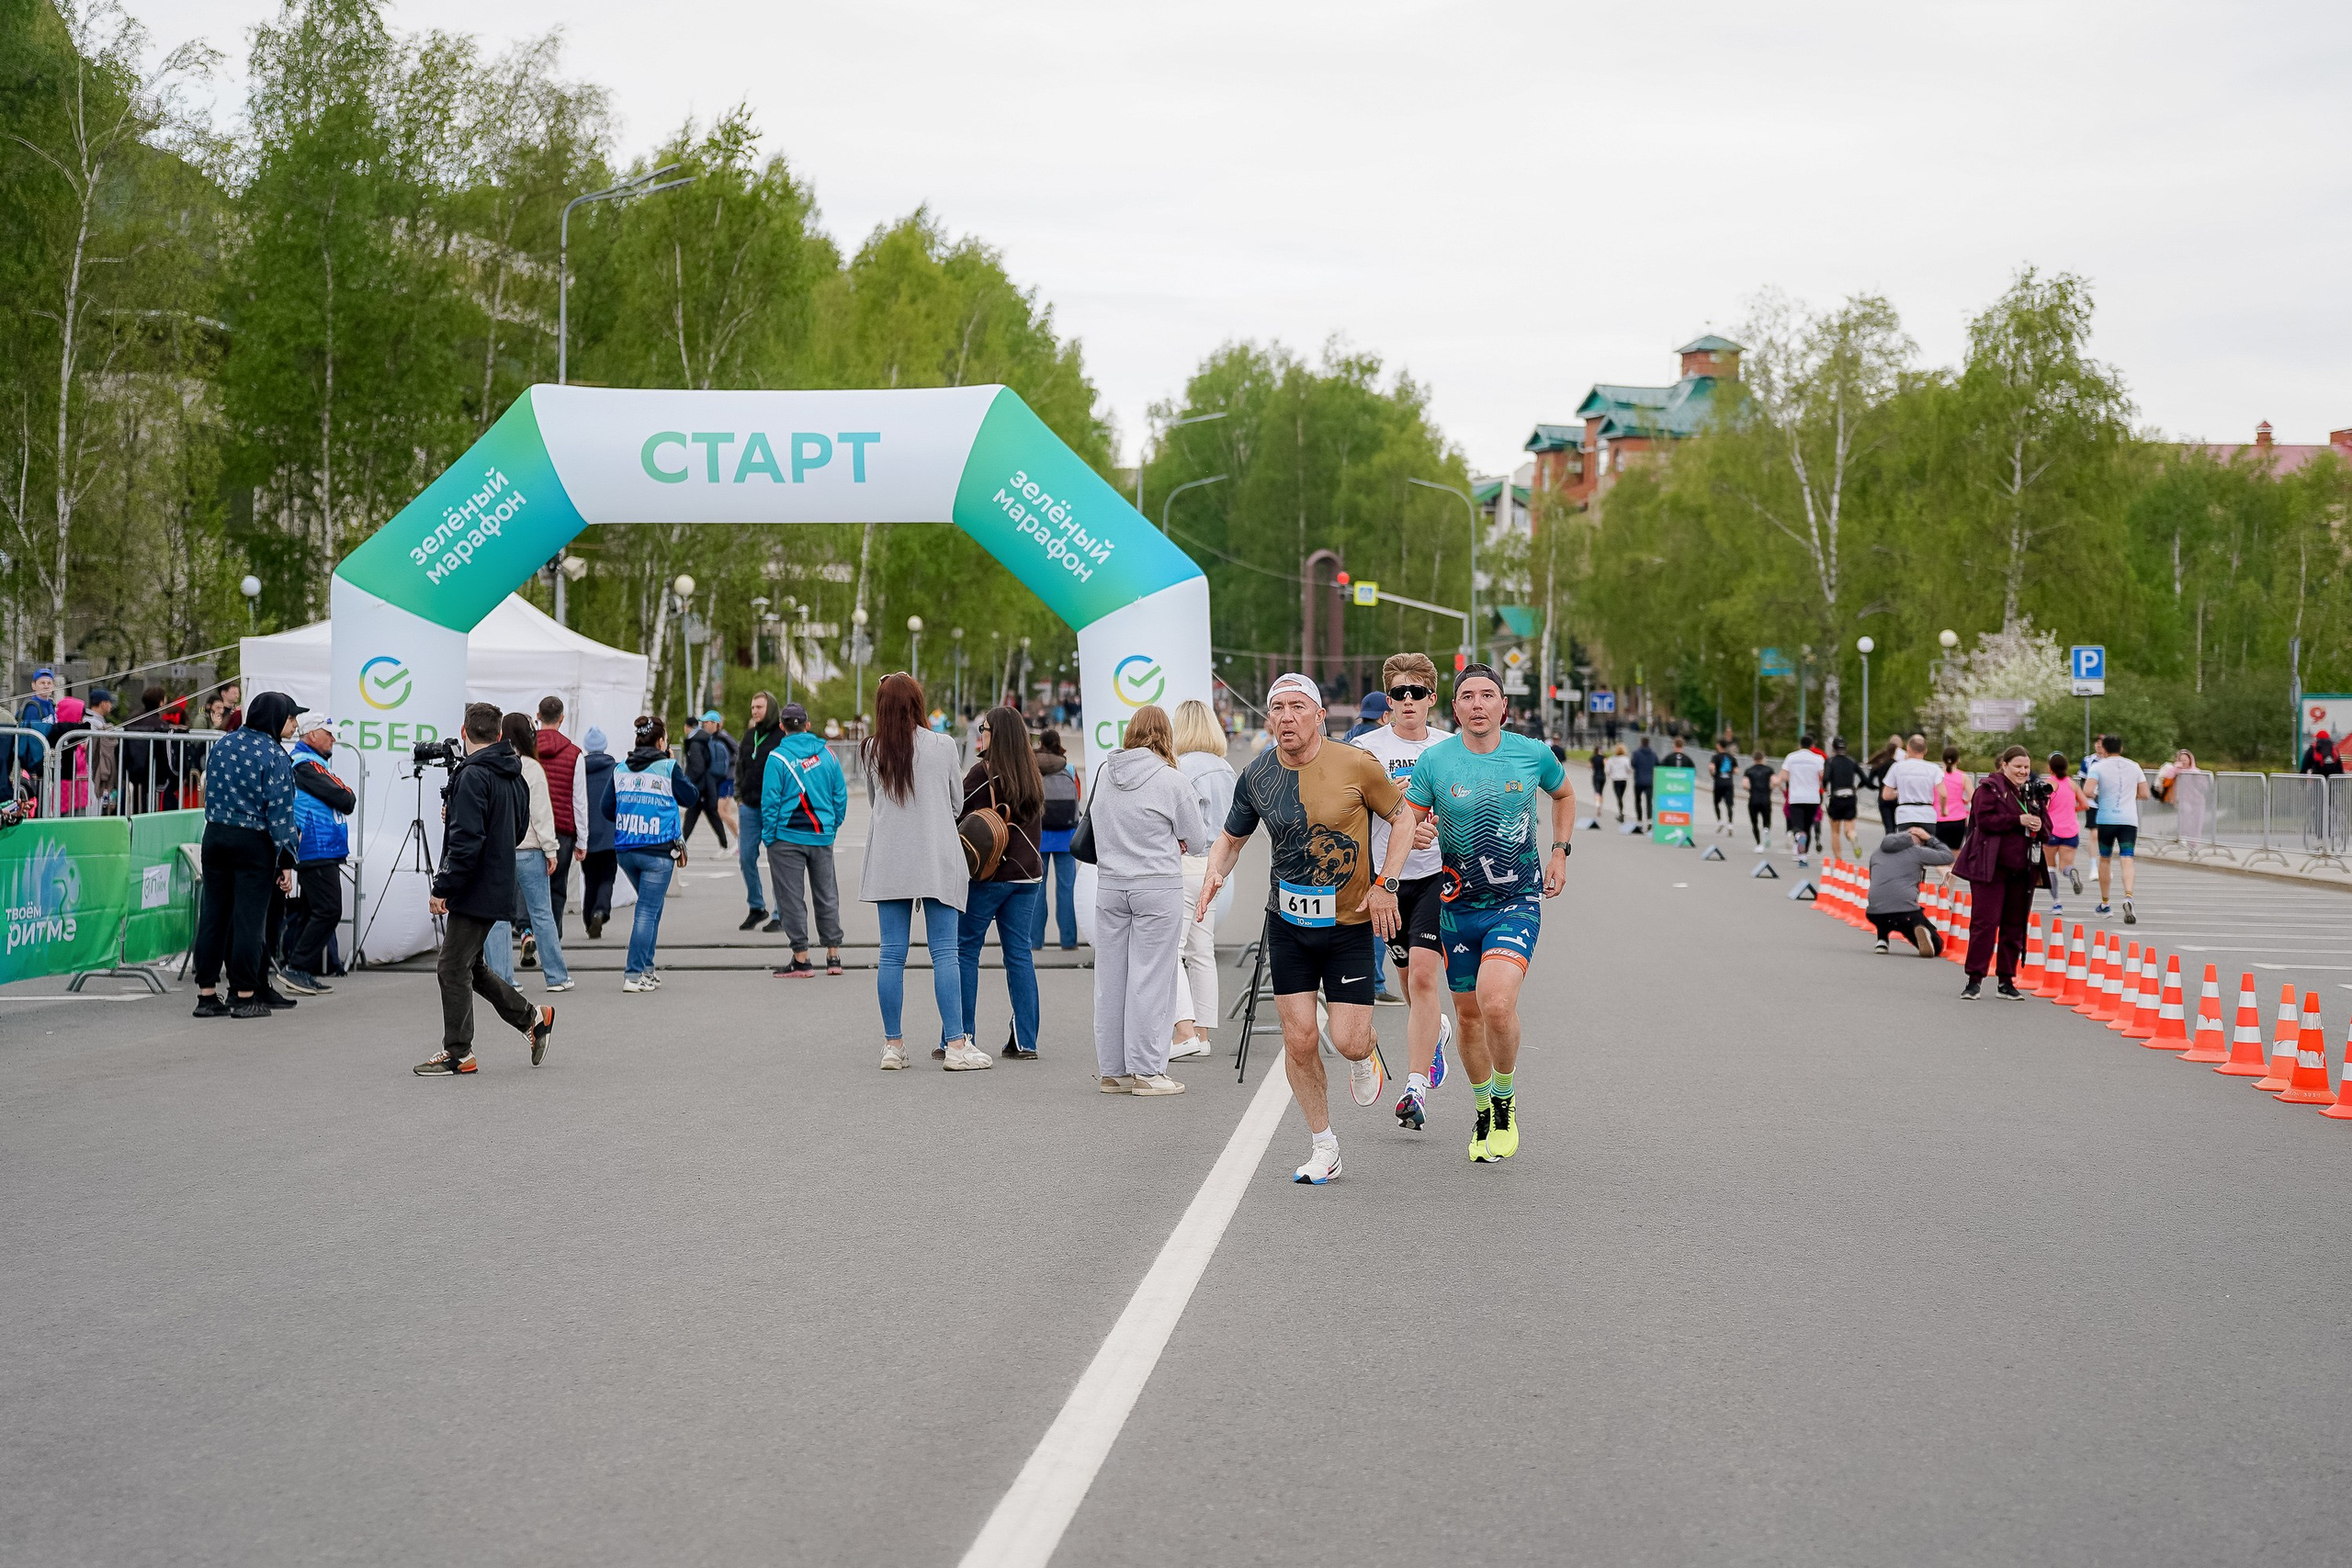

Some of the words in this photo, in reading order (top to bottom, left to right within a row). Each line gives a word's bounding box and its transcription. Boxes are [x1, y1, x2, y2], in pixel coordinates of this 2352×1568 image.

[640, 431, 881, 484] СТАРТ
[409, 466, 510, 566] зелёный
[425, 490, 527, 586] марафон
[991, 488, 1093, 583] марафон
[1009, 470, 1115, 566] зелёный
[2079, 649, 2100, 678] P
[616, 812, 661, 836] СУДЬЯ
[5, 901, 42, 921] твоём
[1288, 897, 1320, 915] 611
[6, 918, 77, 955] ритме
